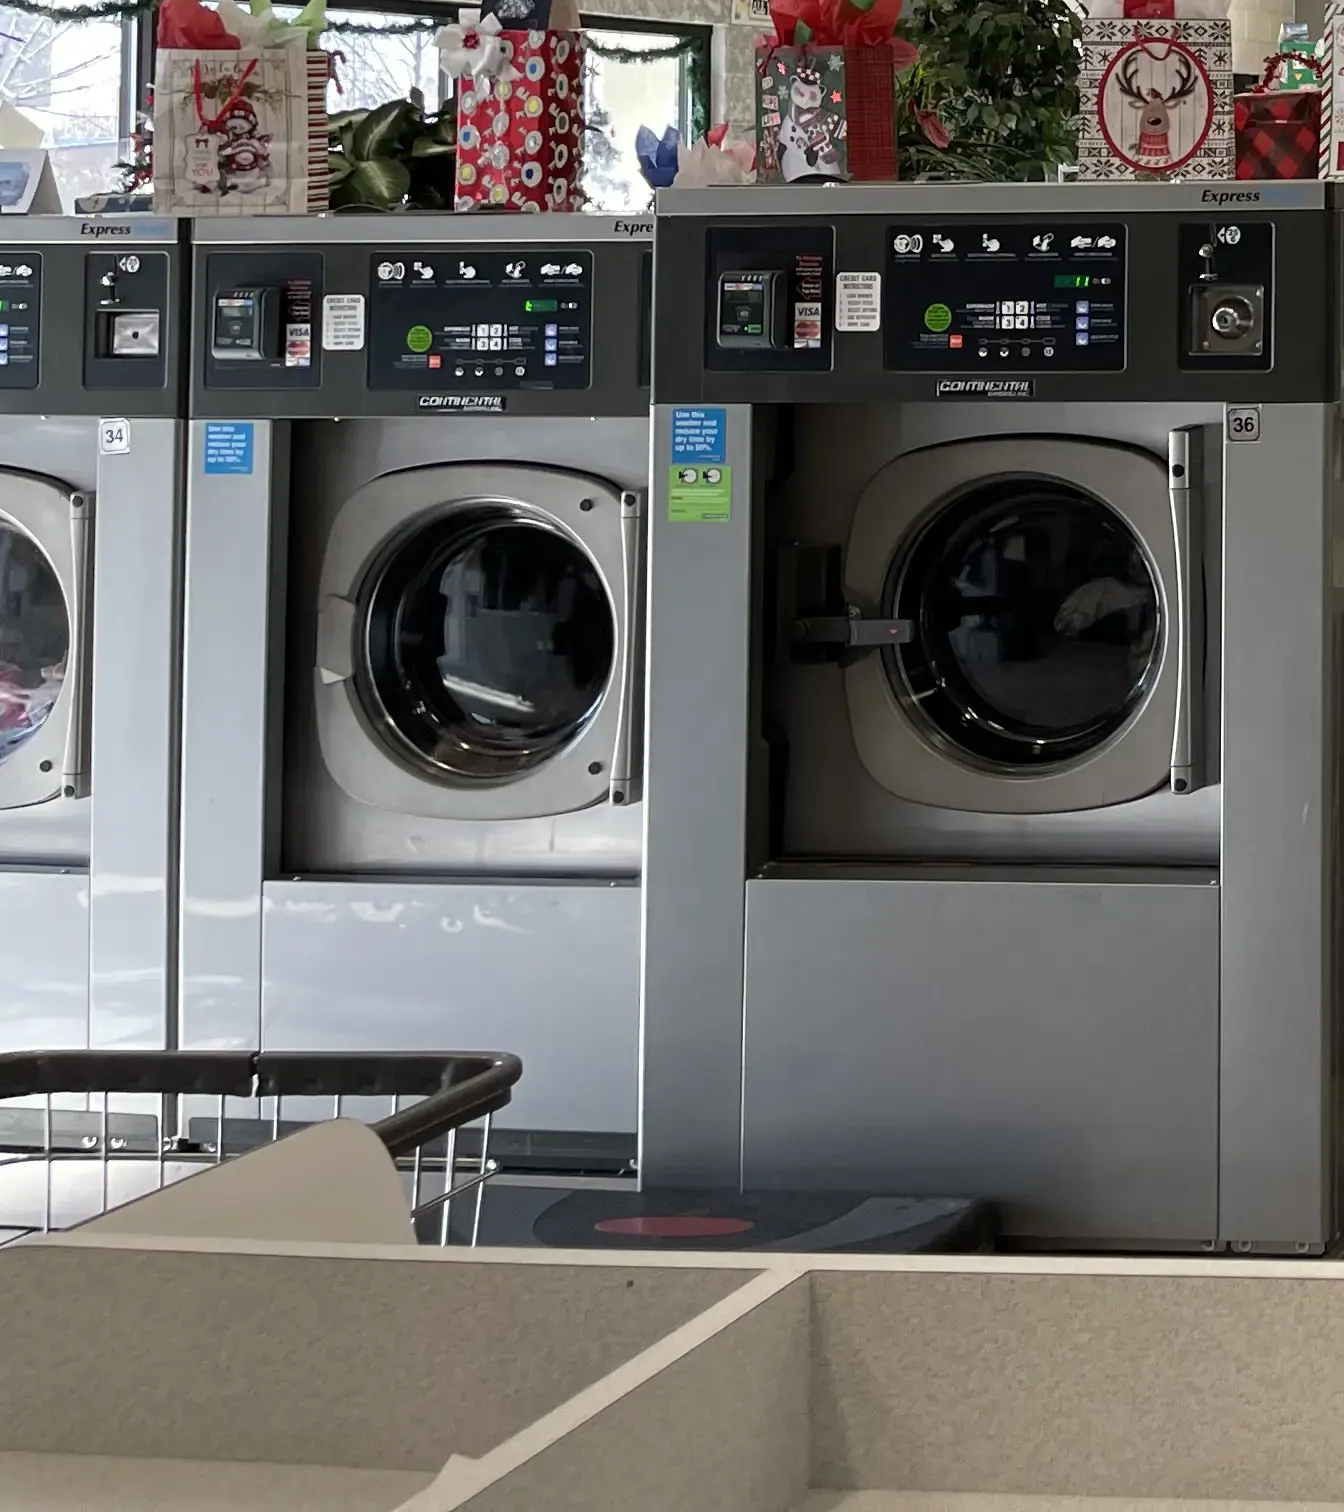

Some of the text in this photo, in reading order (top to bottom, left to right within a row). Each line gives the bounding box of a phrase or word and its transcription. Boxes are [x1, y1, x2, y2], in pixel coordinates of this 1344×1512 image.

[1201, 189, 1261, 206] Express
[80, 223, 131, 238] Express
[613, 219, 653, 238] Expre
[798, 307, 820, 317] VISA
[288, 328, 309, 337] VISA
[938, 380, 1030, 392] CONTINENTAL
[1233, 417, 1255, 433] 36
[105, 429, 124, 444] 34
[675, 436, 687, 444] dry
[706, 436, 716, 444] by
